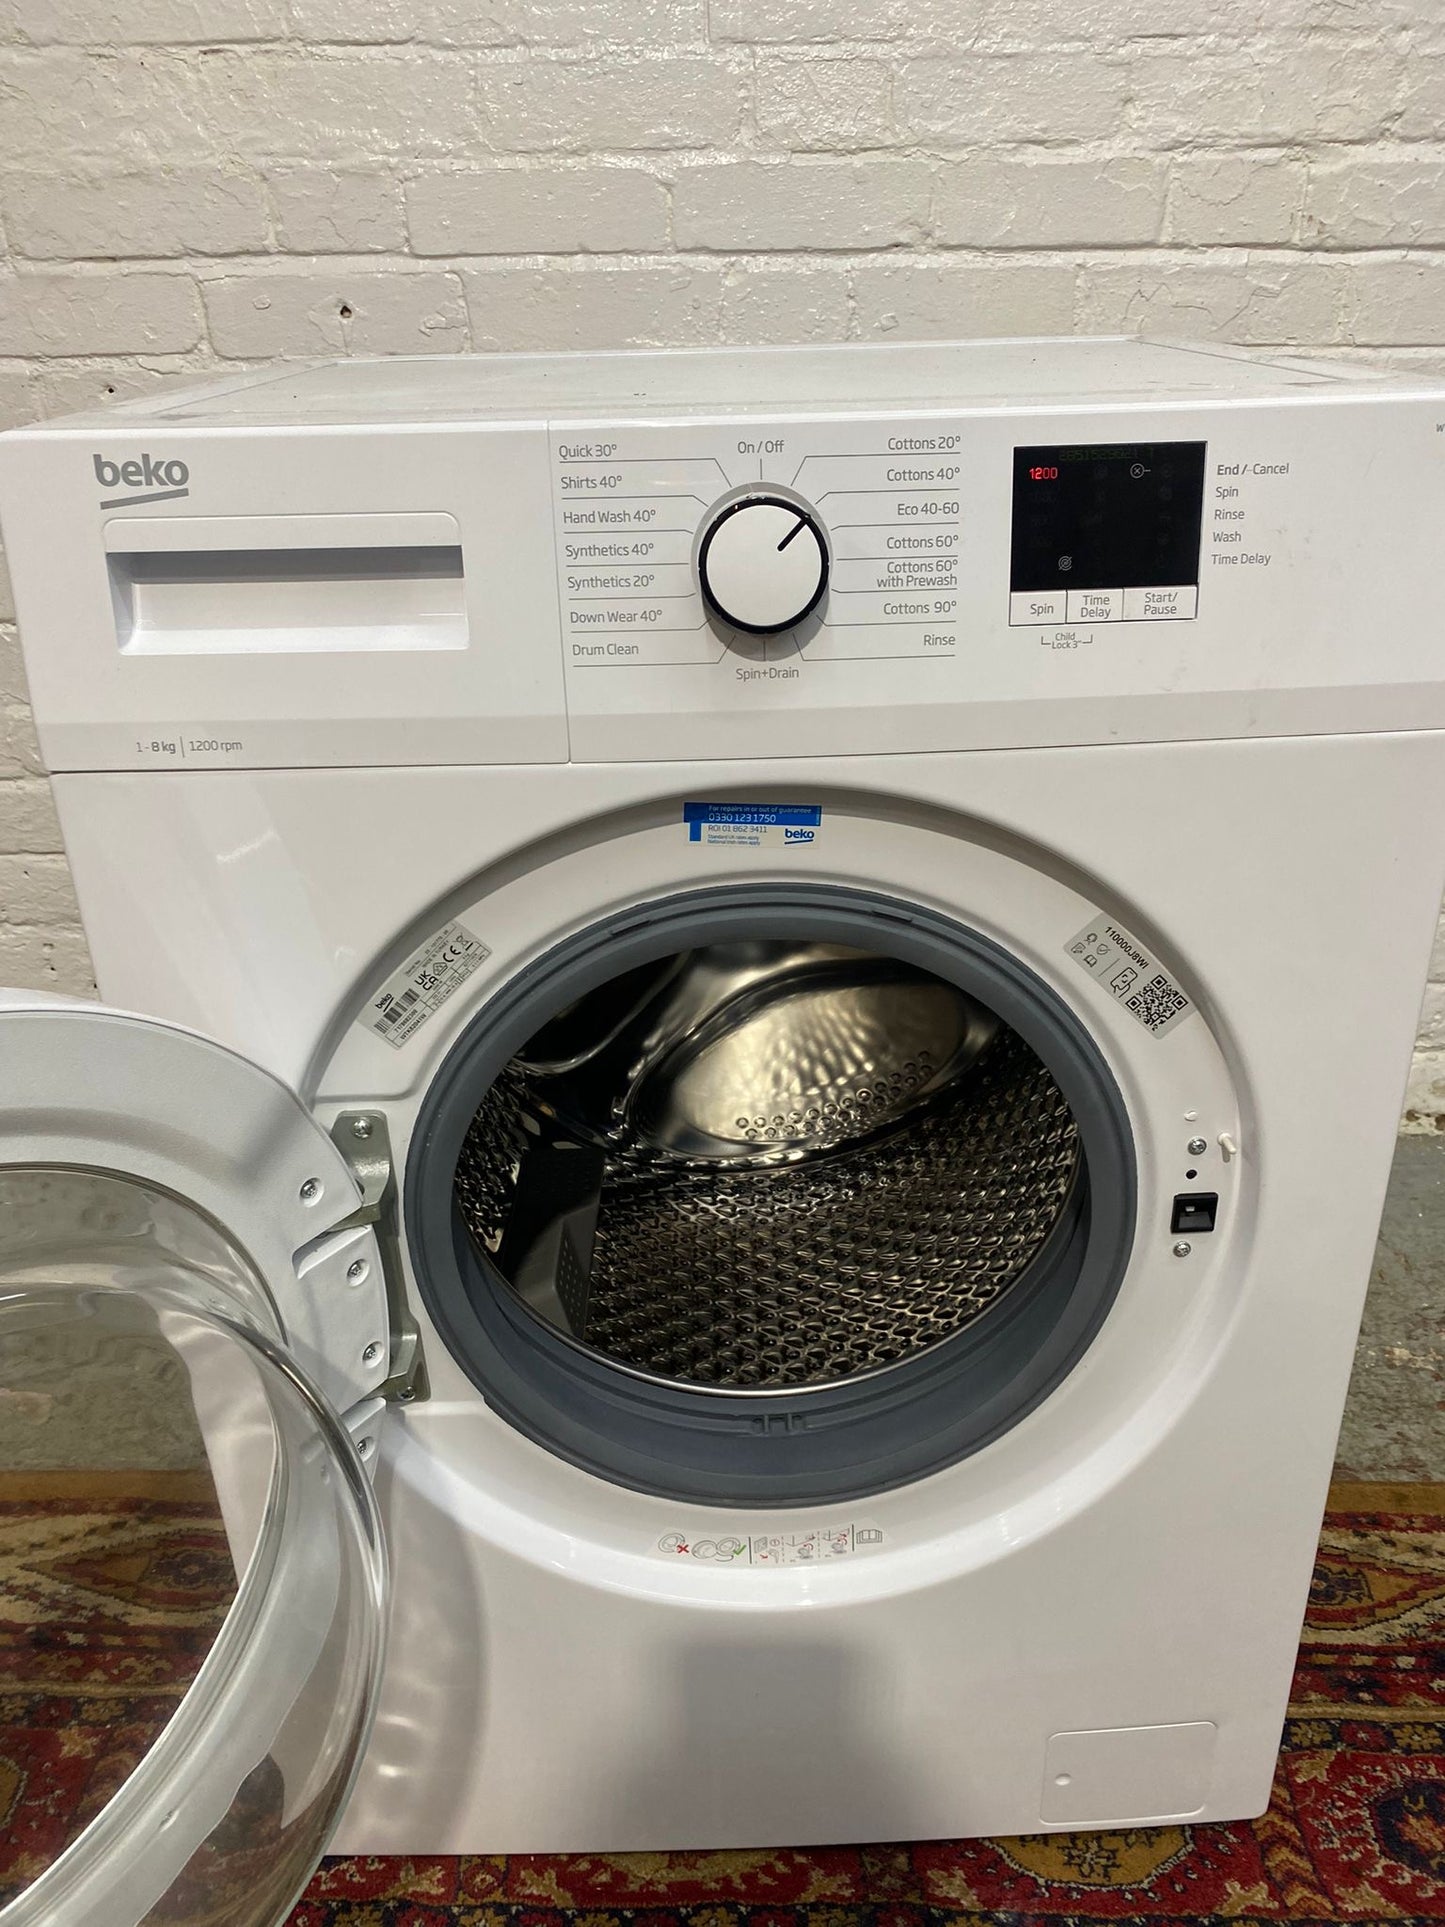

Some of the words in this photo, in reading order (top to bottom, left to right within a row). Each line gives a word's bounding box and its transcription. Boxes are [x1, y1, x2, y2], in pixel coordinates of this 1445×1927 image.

[737, 441, 755, 454] On
[764, 440, 784, 454] Off
[887, 438, 936, 450] Cottons
[559, 445, 592, 458] Quick
[92, 453, 189, 487] beko
[887, 469, 935, 481] Cottons
[1029, 467, 1058, 480] 1200
[1217, 464, 1239, 475] End
[561, 476, 597, 489] Shirts
[1216, 486, 1238, 499] Spin
[897, 503, 919, 516] Eco
[921, 502, 960, 515] 40-60
[1214, 509, 1245, 520] Rinse
[563, 511, 595, 523] Hand
[597, 510, 631, 523] Wash
[886, 536, 933, 549] Cottons
[1213, 531, 1241, 542] Wash
[565, 544, 629, 559] Synthetics
[1211, 554, 1238, 564] Time
[1241, 553, 1271, 566] Delay
[887, 561, 933, 573] Cottons
[567, 575, 630, 590] Synthetics
[877, 575, 904, 587] with
[906, 574, 957, 587] Prewash
[1082, 595, 1110, 605] Time
[883, 602, 930, 615] Cottons
[1030, 604, 1054, 616] Spin
[1081, 607, 1111, 619] Delay
[1144, 605, 1177, 615] Pause
[570, 611, 605, 623] Down
[606, 610, 639, 623] Wear
[923, 633, 956, 646] Rinse
[1055, 632, 1075, 641] Child
[572, 644, 604, 656] Drum
[606, 643, 639, 655] Clean
[1052, 640, 1071, 649] Lock
[161, 741, 176, 754] kg
[188, 740, 218, 751] 1200
[220, 741, 242, 752] rpm
[708, 813, 733, 821] 0330
[735, 814, 751, 822] 123
[754, 814, 776, 823] 1750
[785, 829, 814, 839] beko
[414, 970, 431, 986] UK
[422, 976, 438, 991] CA
[375, 993, 392, 1010] beko
